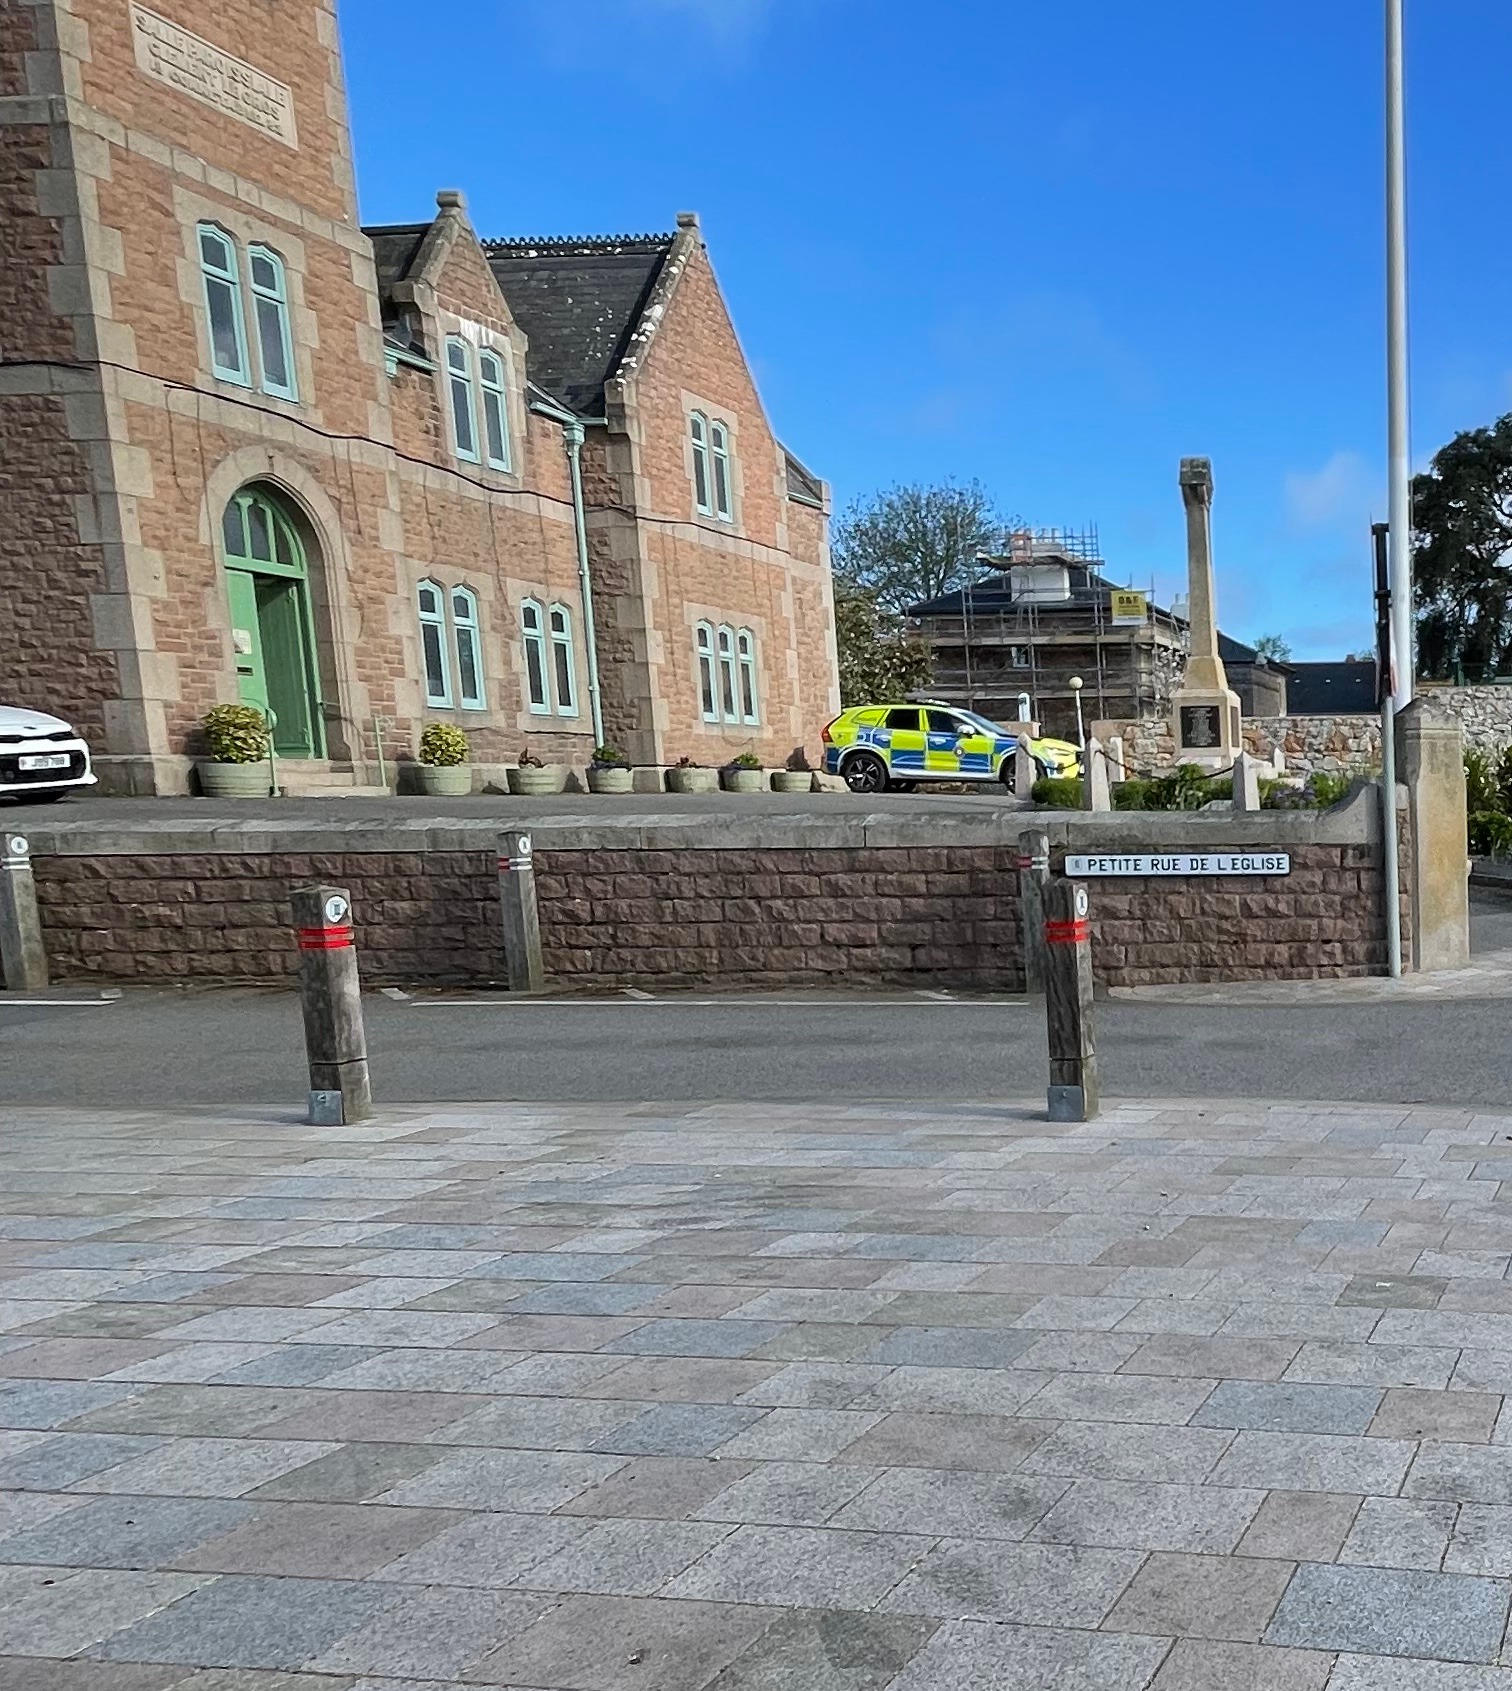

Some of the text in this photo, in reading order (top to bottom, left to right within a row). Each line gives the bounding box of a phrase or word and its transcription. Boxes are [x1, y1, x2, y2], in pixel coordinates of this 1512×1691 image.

[1087, 858, 1143, 872] PETITE
[1150, 858, 1181, 871] RUE
[1189, 858, 1209, 871] DE
